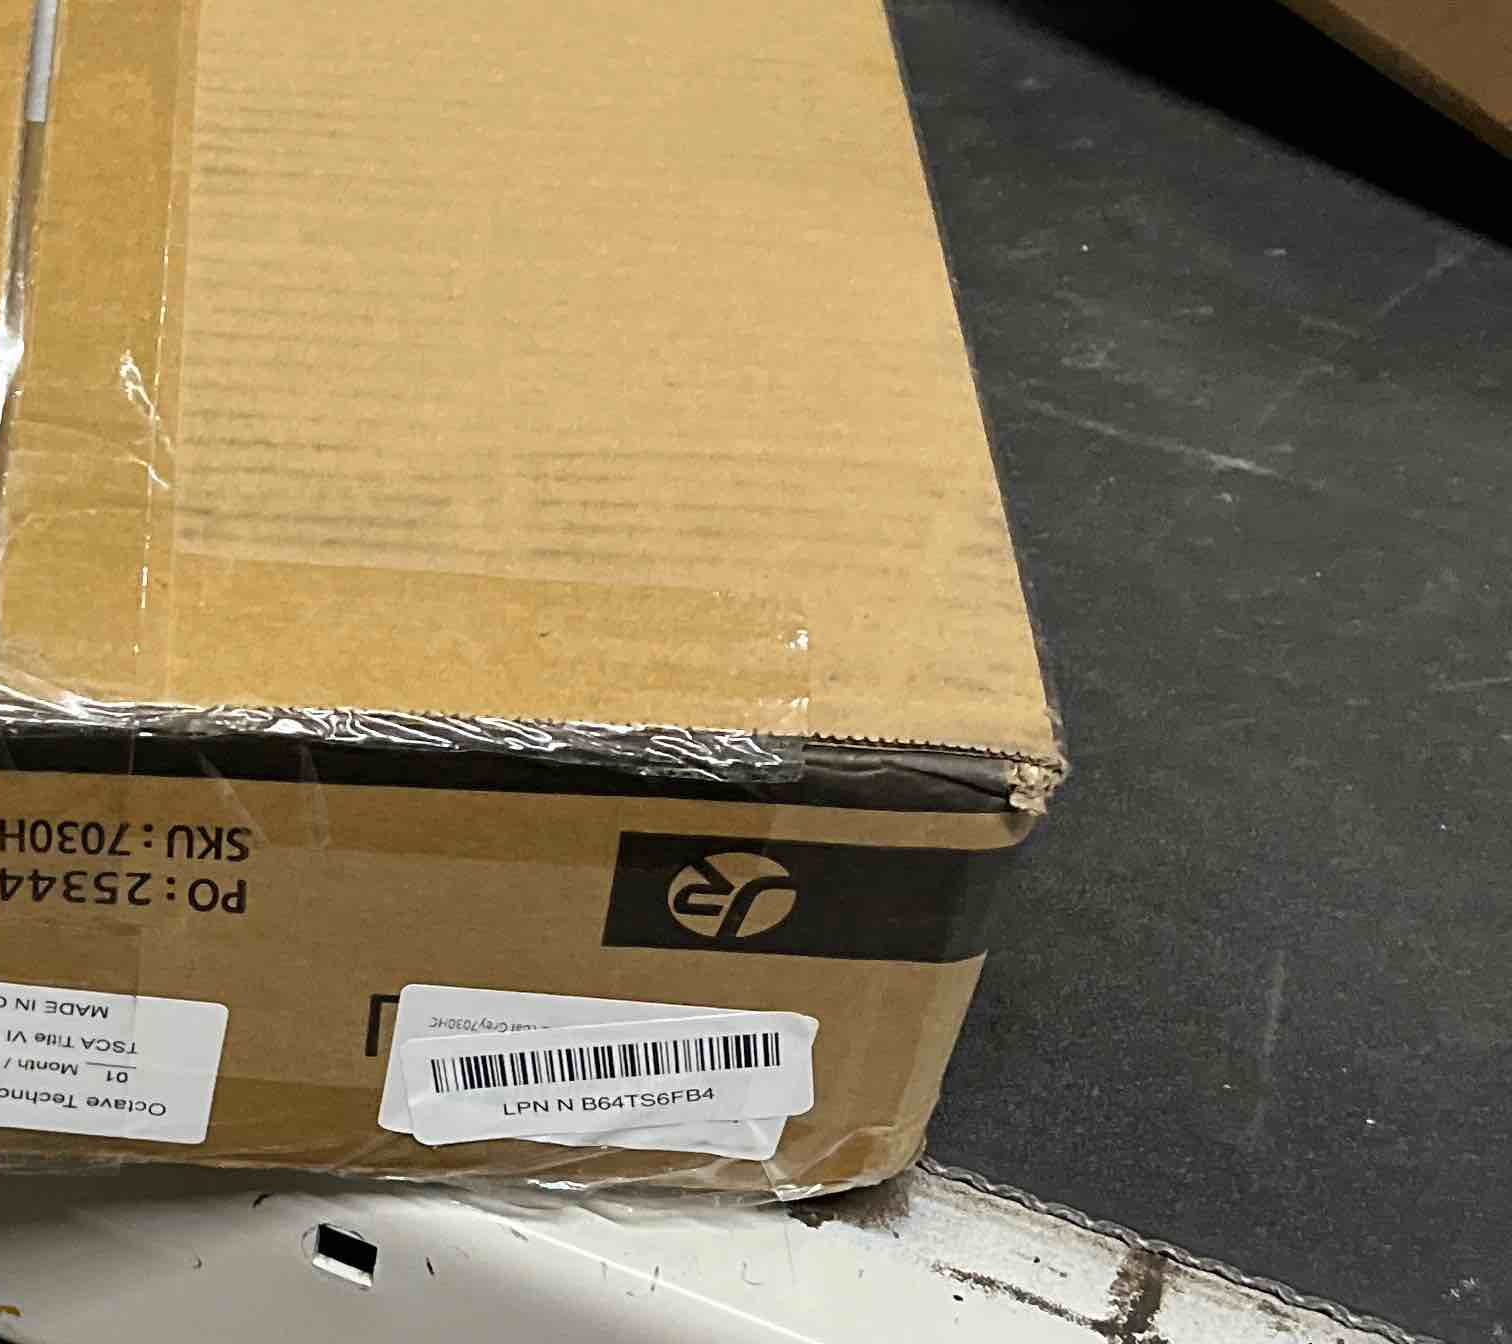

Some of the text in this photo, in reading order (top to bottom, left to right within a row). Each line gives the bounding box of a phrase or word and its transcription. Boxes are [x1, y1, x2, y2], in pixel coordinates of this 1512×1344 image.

[16, 997, 36, 1011] IN
[45, 1000, 109, 1019] MADE
[6, 1029, 27, 1043] VI
[34, 1032, 75, 1048] Title
[80, 1037, 139, 1054] TSCA
[17, 1057, 79, 1076] Month
[105, 1070, 129, 1084] 01
[86, 1096, 167, 1116] Octave
[503, 1087, 715, 1116] LPN N B64TS6FB4
